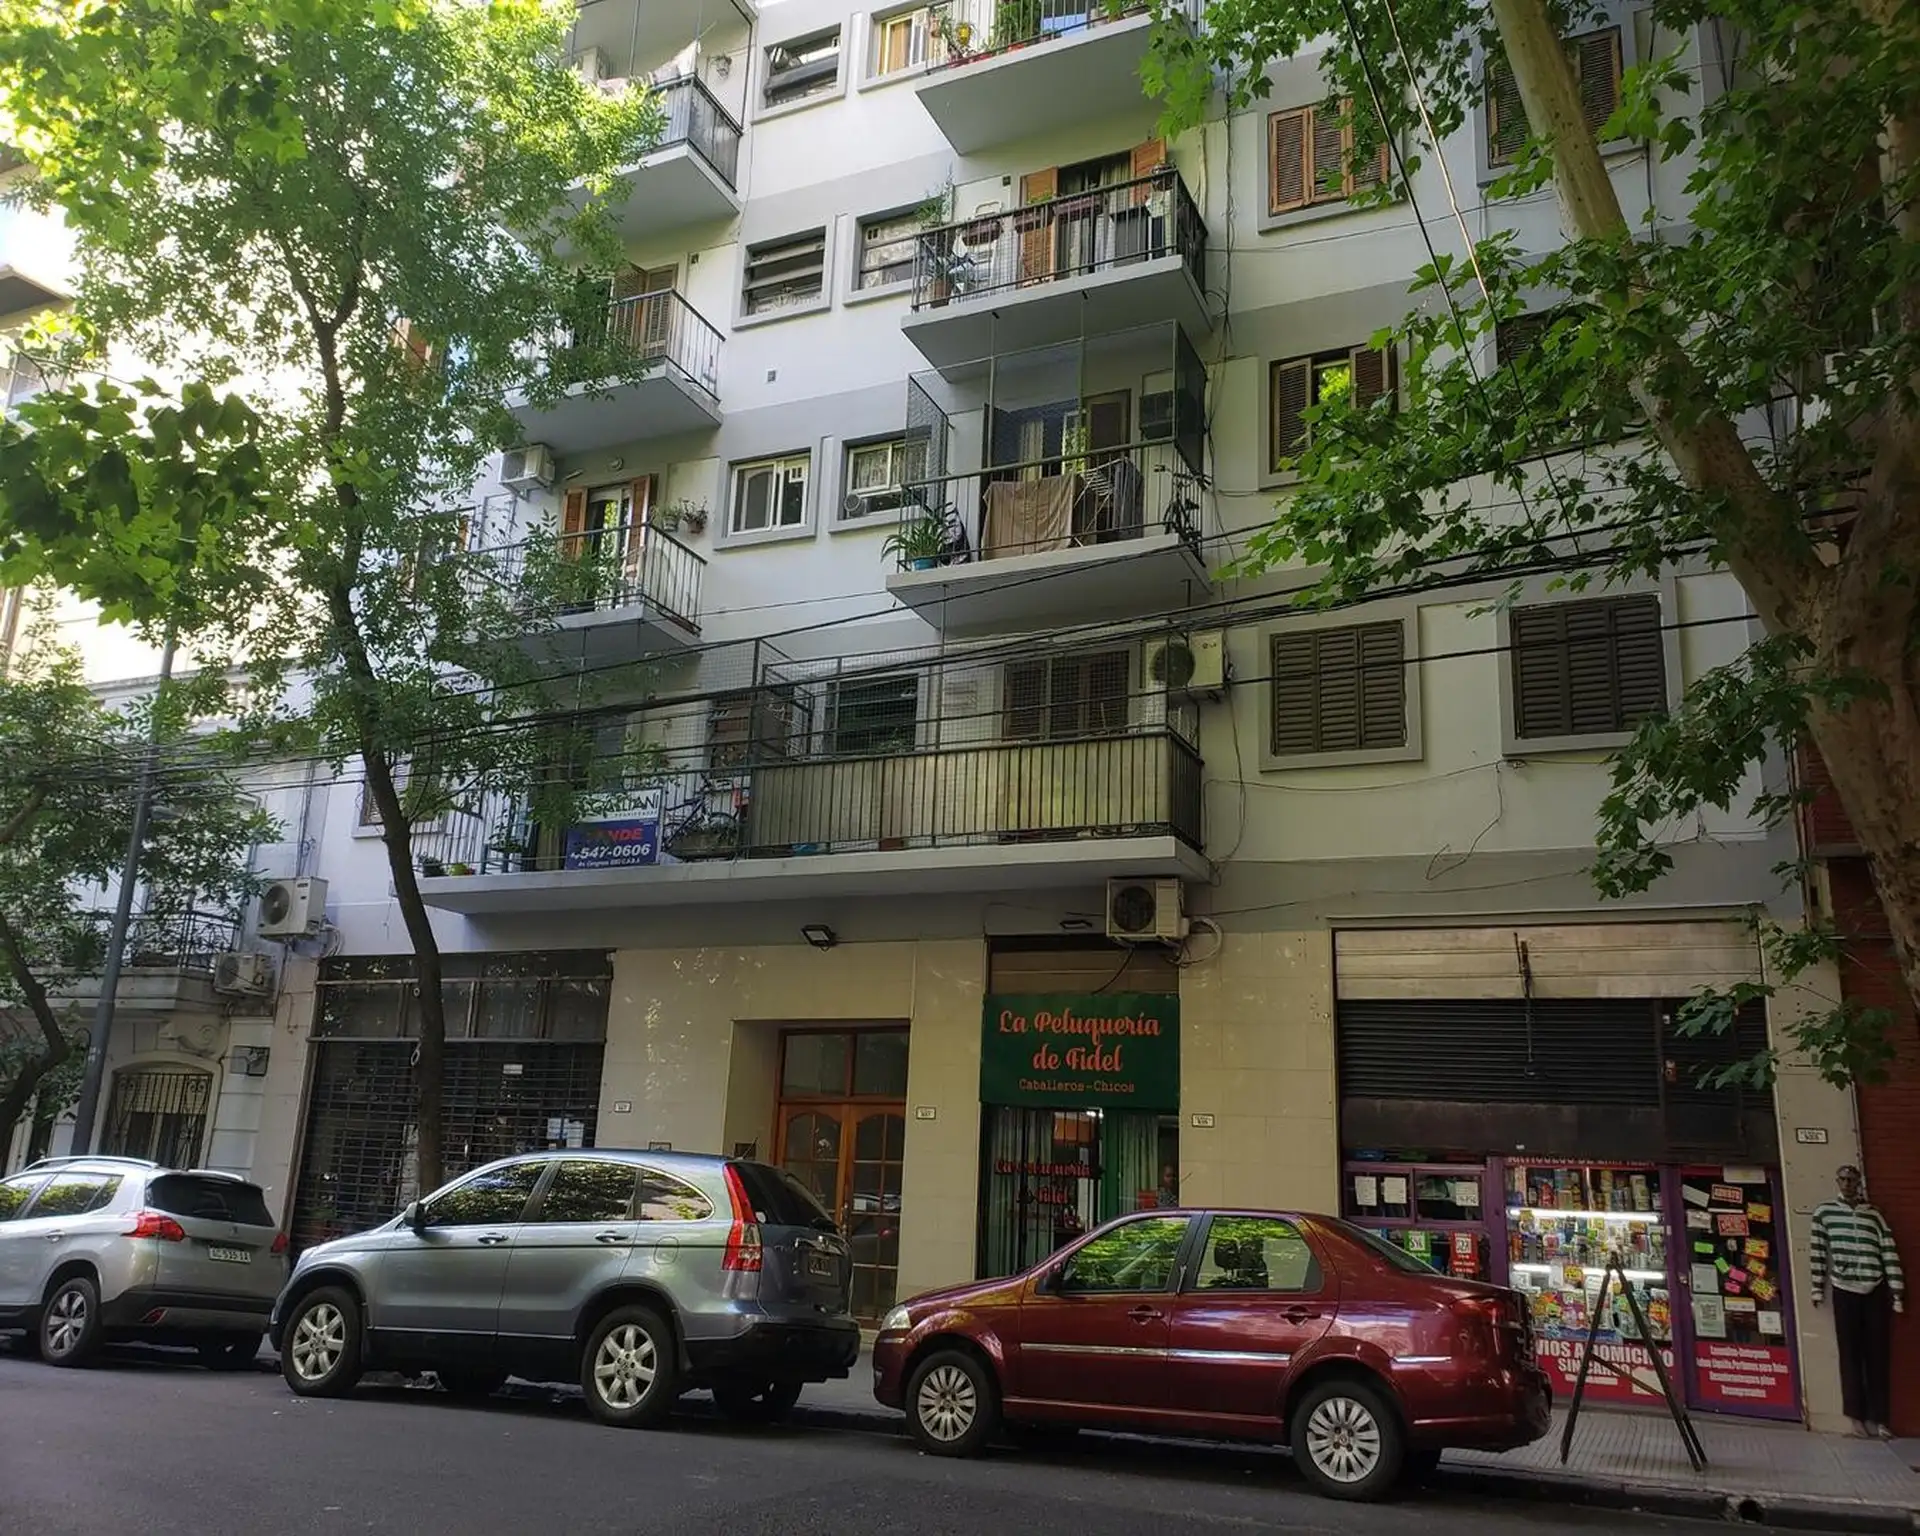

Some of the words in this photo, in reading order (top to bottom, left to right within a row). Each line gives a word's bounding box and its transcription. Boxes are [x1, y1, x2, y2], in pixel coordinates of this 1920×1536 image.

[1000, 1010, 1028, 1033] La
[1034, 1008, 1161, 1045] Peluquería
[1033, 1043, 1061, 1070] de
[1066, 1044, 1124, 1072] Fidel
